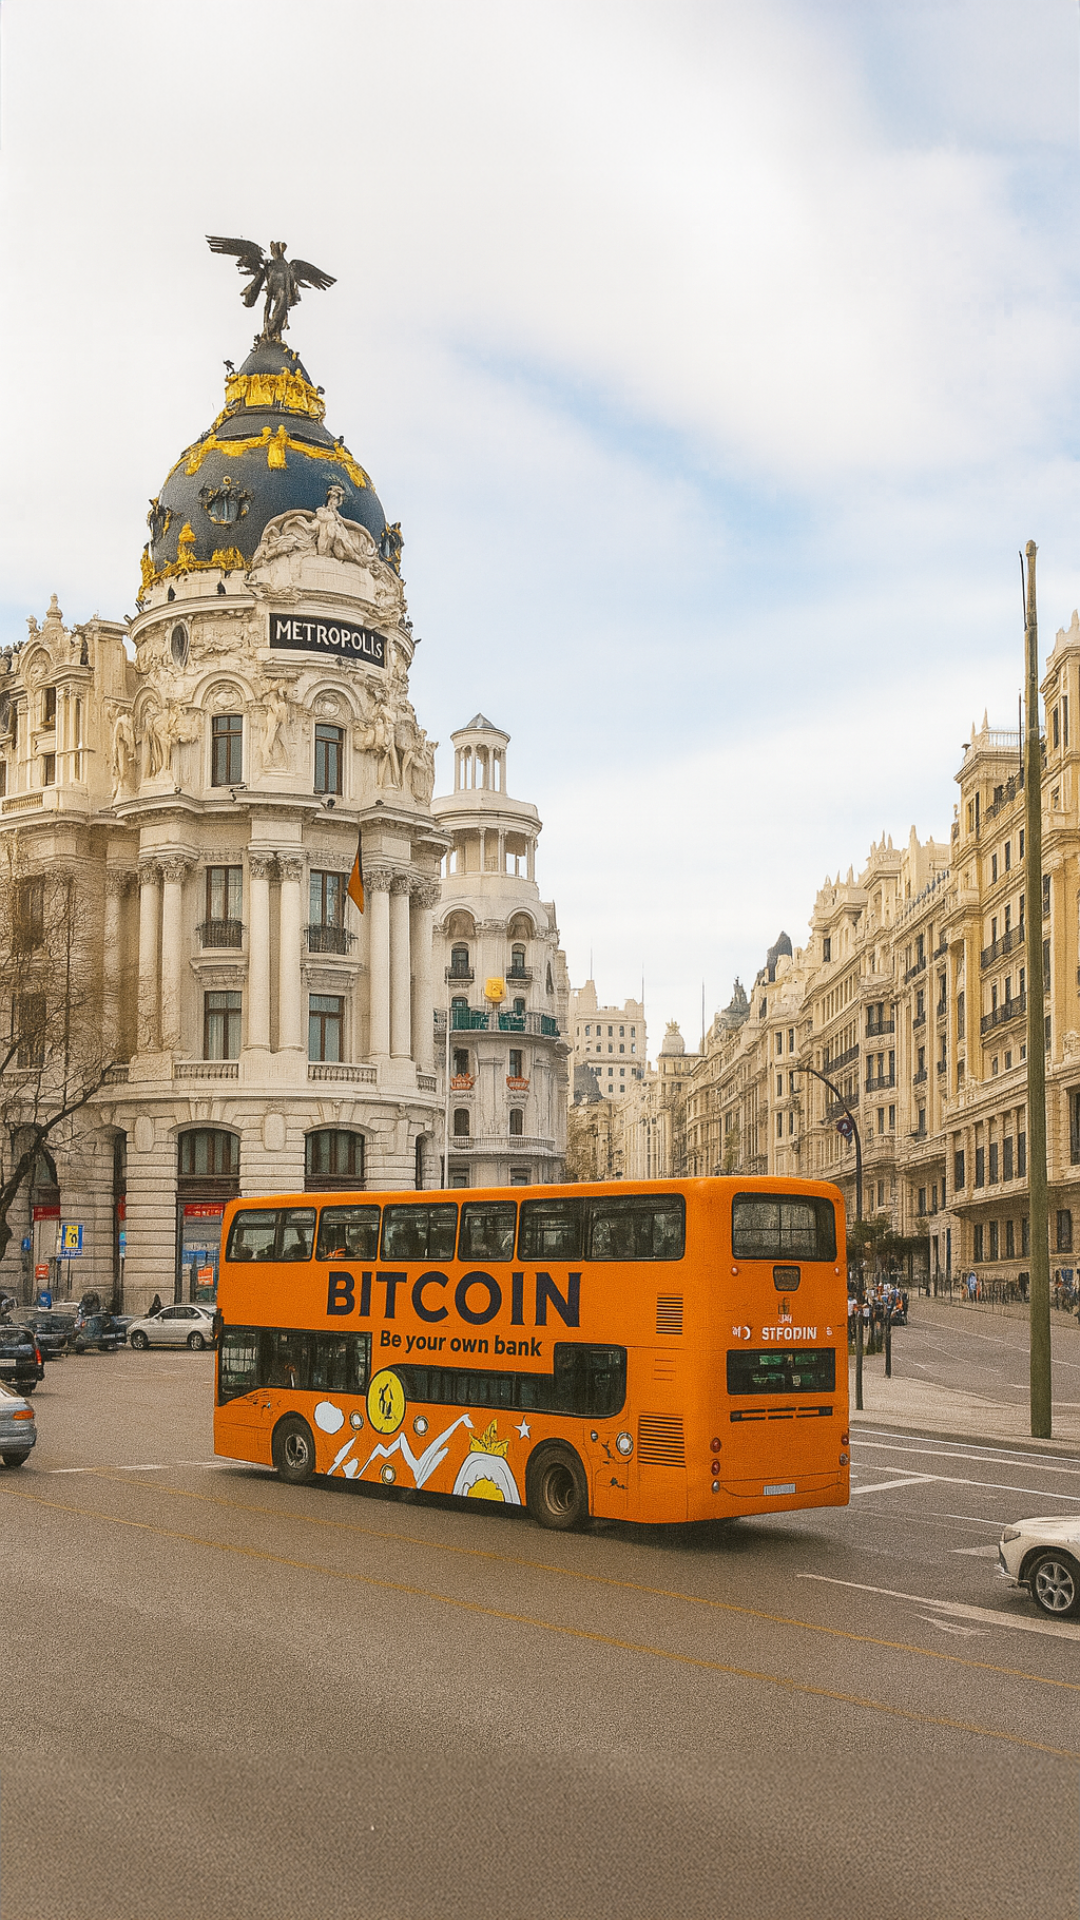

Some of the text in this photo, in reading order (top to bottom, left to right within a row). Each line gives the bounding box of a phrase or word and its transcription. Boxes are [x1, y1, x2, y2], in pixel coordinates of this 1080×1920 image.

[276, 620, 382, 658] METROPOLIS
[326, 1271, 582, 1327] BITCOIN
[380, 1330, 542, 1356] Be your own bank
